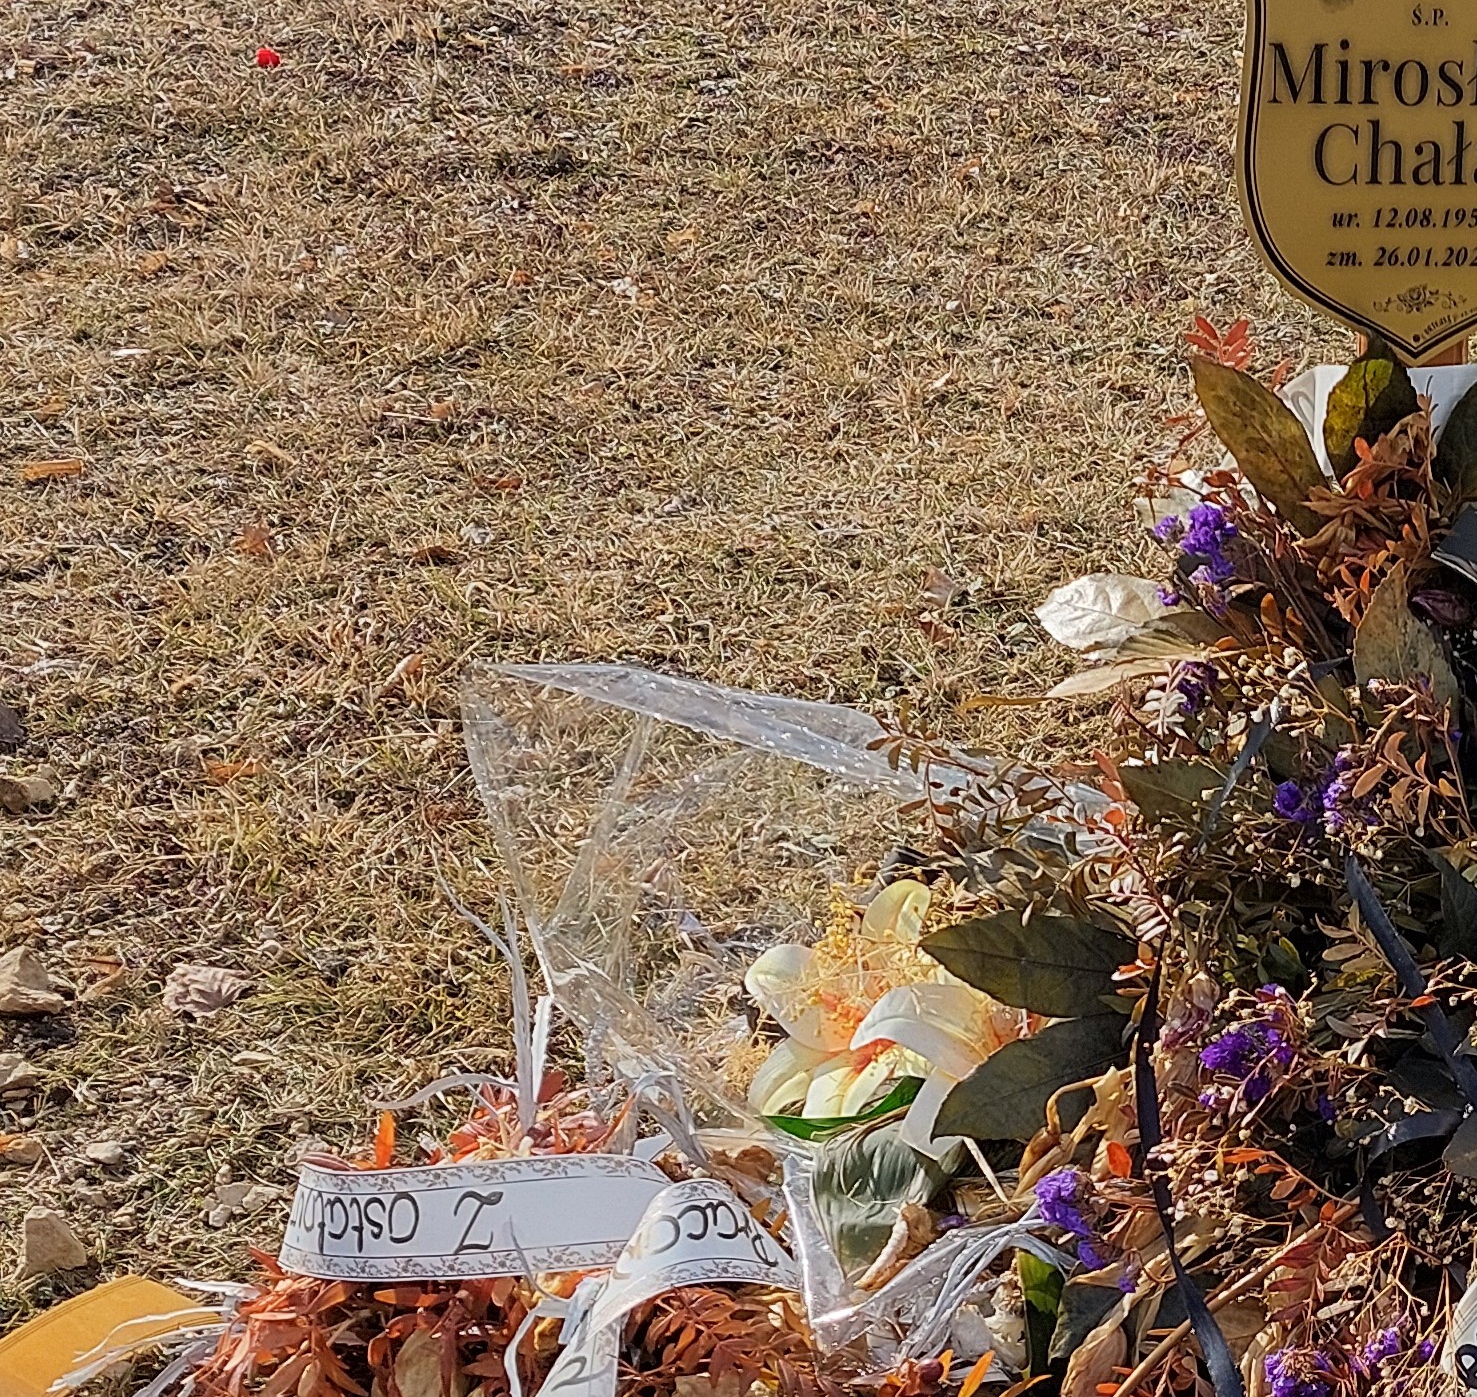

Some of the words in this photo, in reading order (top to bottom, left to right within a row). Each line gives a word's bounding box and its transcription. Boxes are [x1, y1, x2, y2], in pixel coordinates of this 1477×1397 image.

[1331, 211, 1361, 229] ur.
[1325, 249, 1363, 268] zm.
[288, 1190, 420, 1255] ostatni
[454, 1190, 504, 1255] Z
